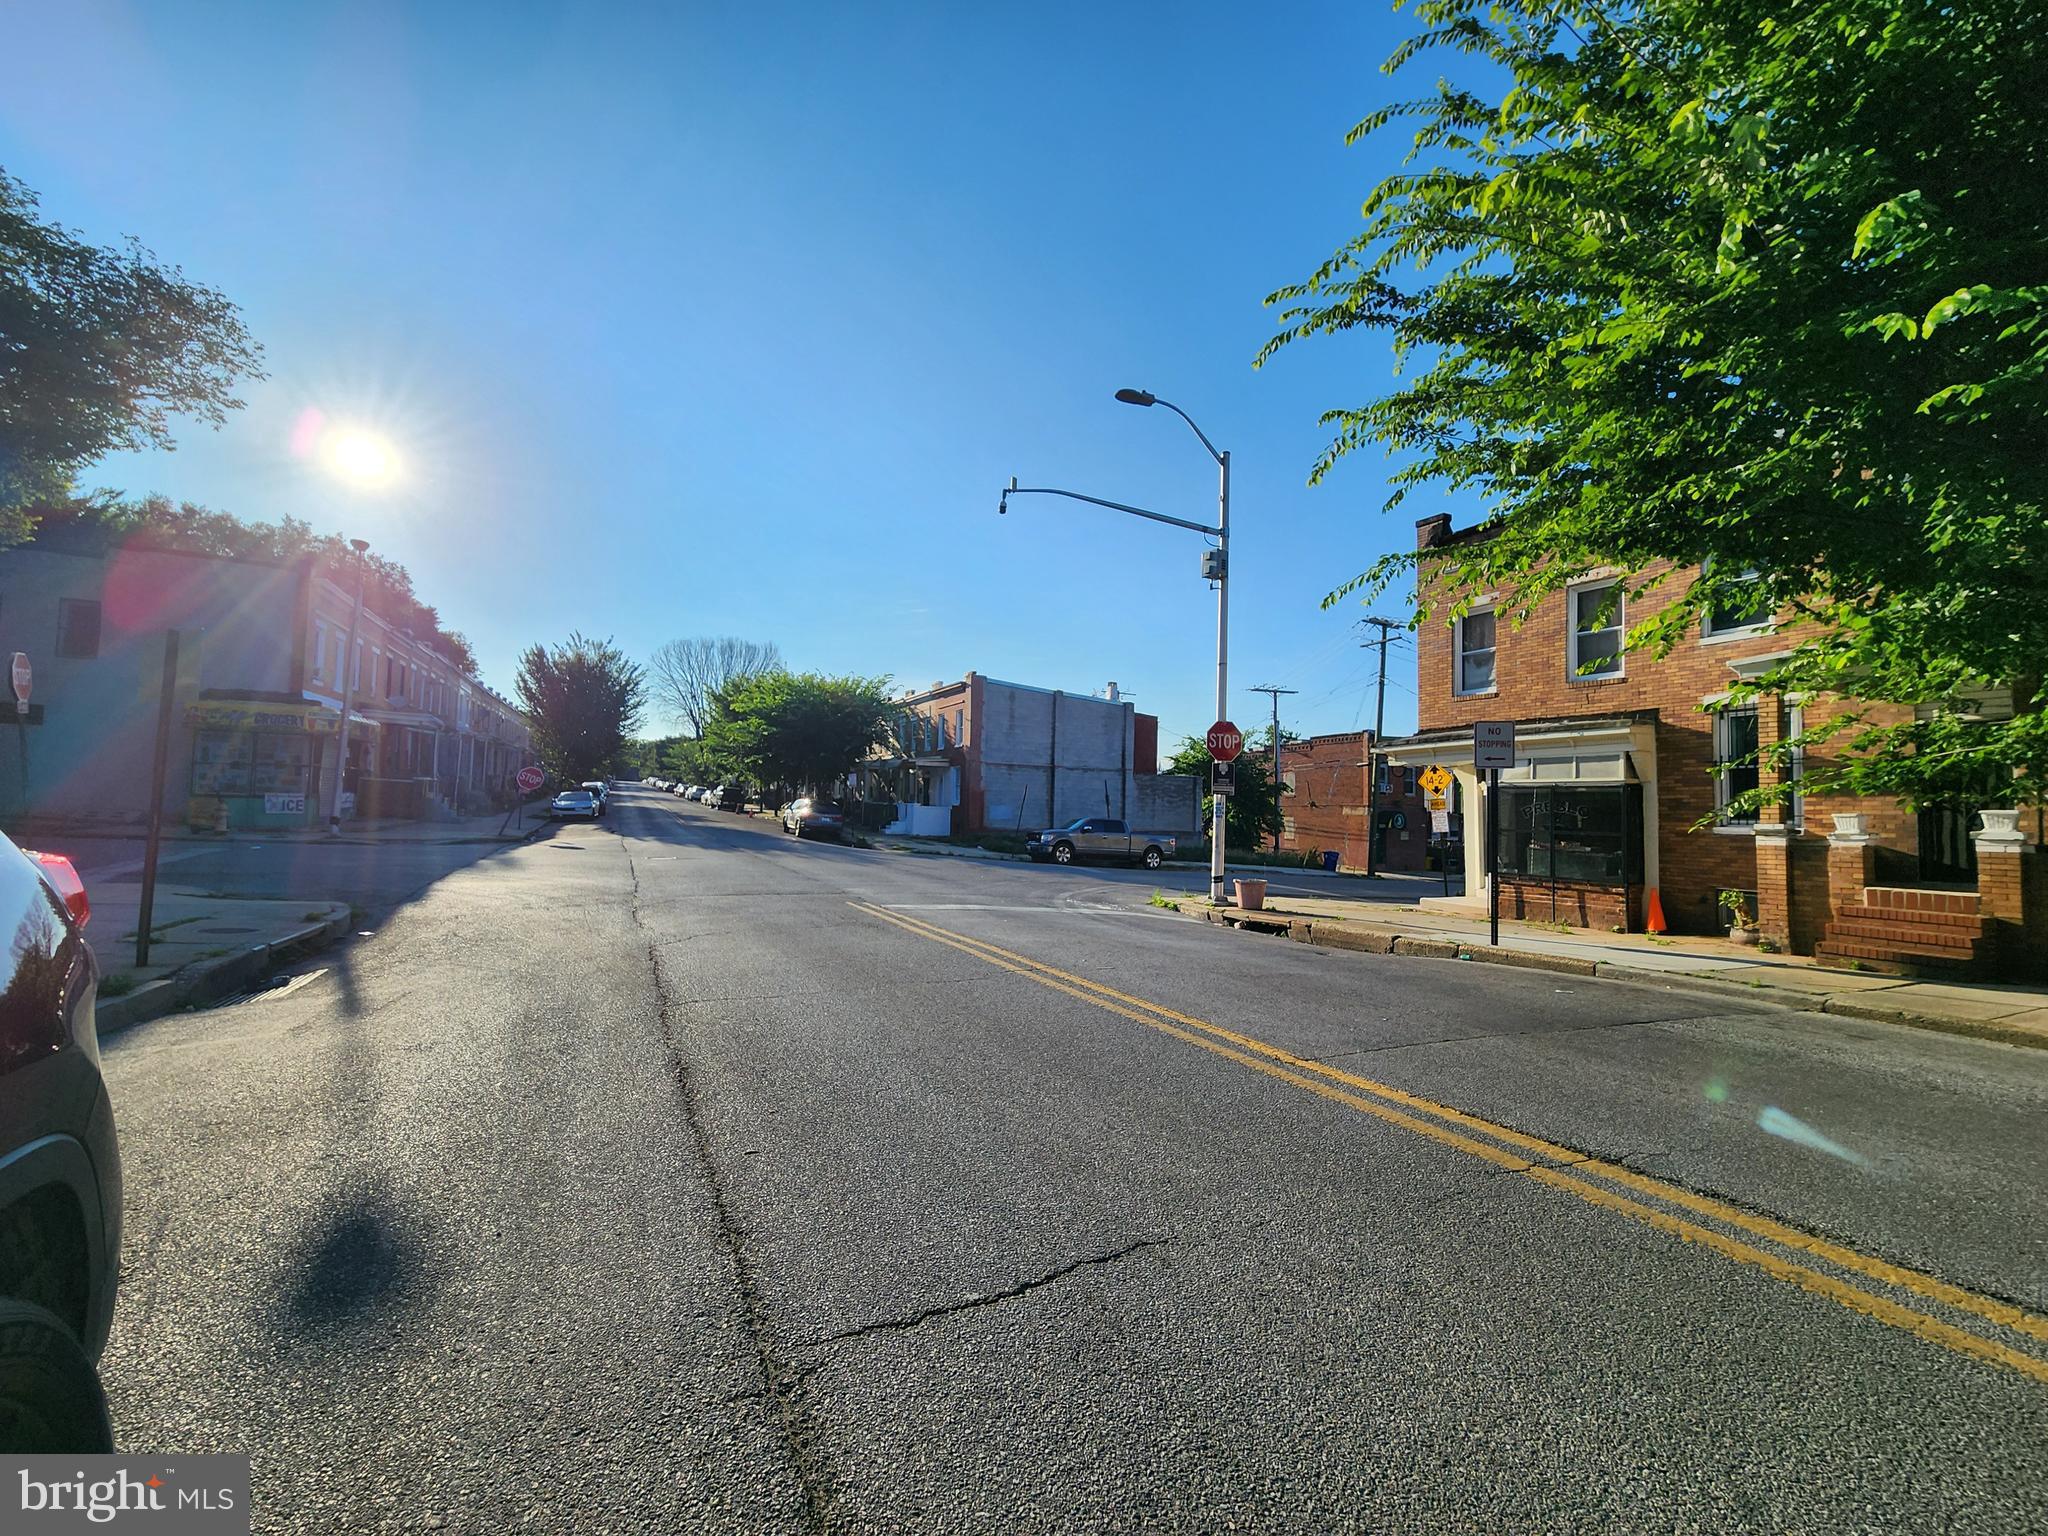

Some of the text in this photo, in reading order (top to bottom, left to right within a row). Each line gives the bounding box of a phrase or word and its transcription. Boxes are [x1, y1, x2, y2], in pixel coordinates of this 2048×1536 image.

[1487, 727, 1502, 736] NO
[1208, 733, 1240, 750] STOP
[1478, 740, 1512, 749] STOPPING
[520, 771, 542, 785] STOP
[281, 799, 304, 812] ICE
